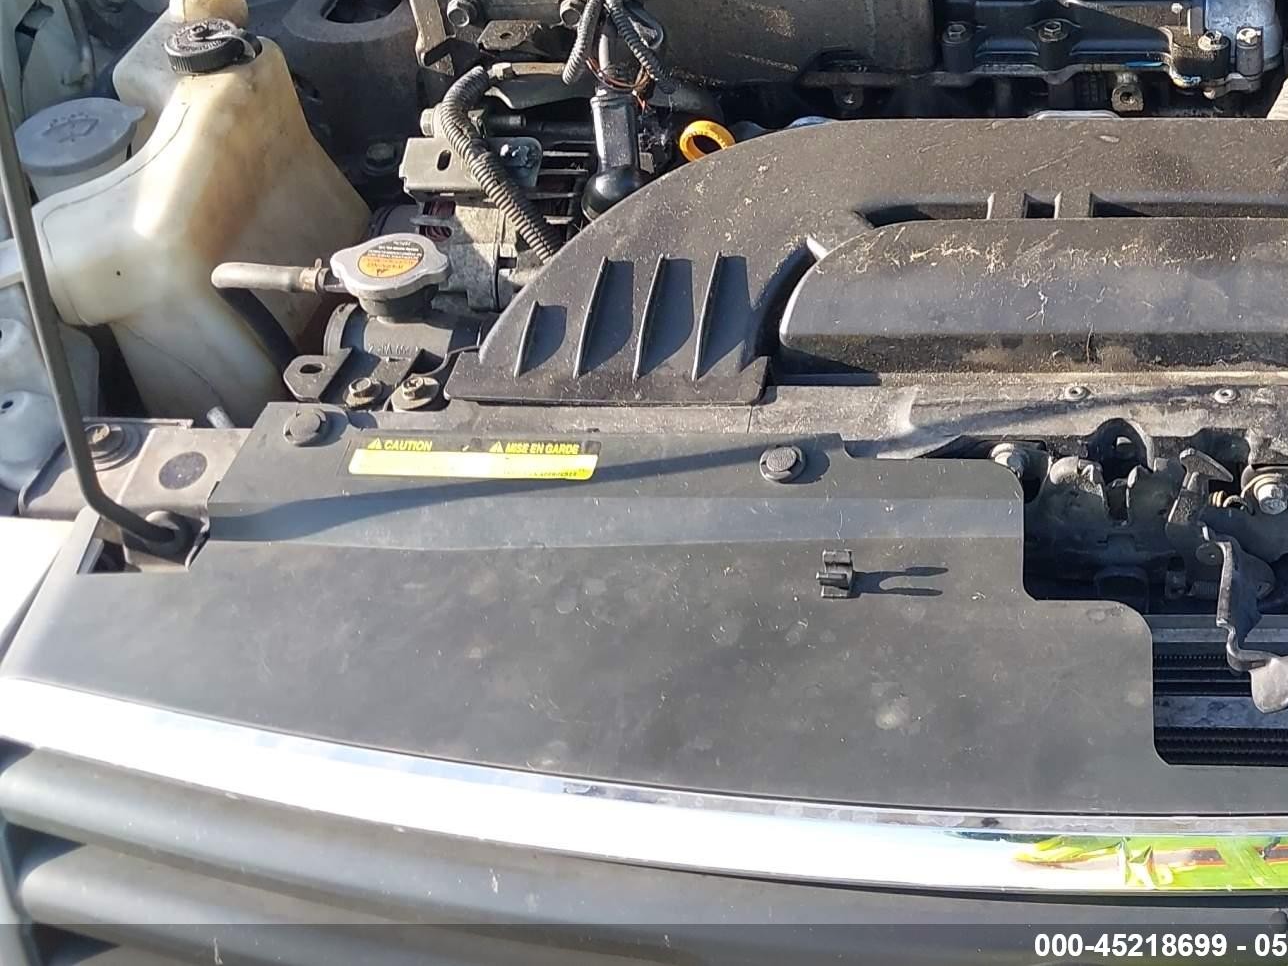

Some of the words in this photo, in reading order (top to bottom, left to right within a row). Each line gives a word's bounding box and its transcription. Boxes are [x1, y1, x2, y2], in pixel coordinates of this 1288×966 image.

[383, 439, 433, 452] CAUTION
[504, 442, 529, 454] MISE
[529, 442, 544, 454] EN
[545, 443, 580, 455] GARDE
